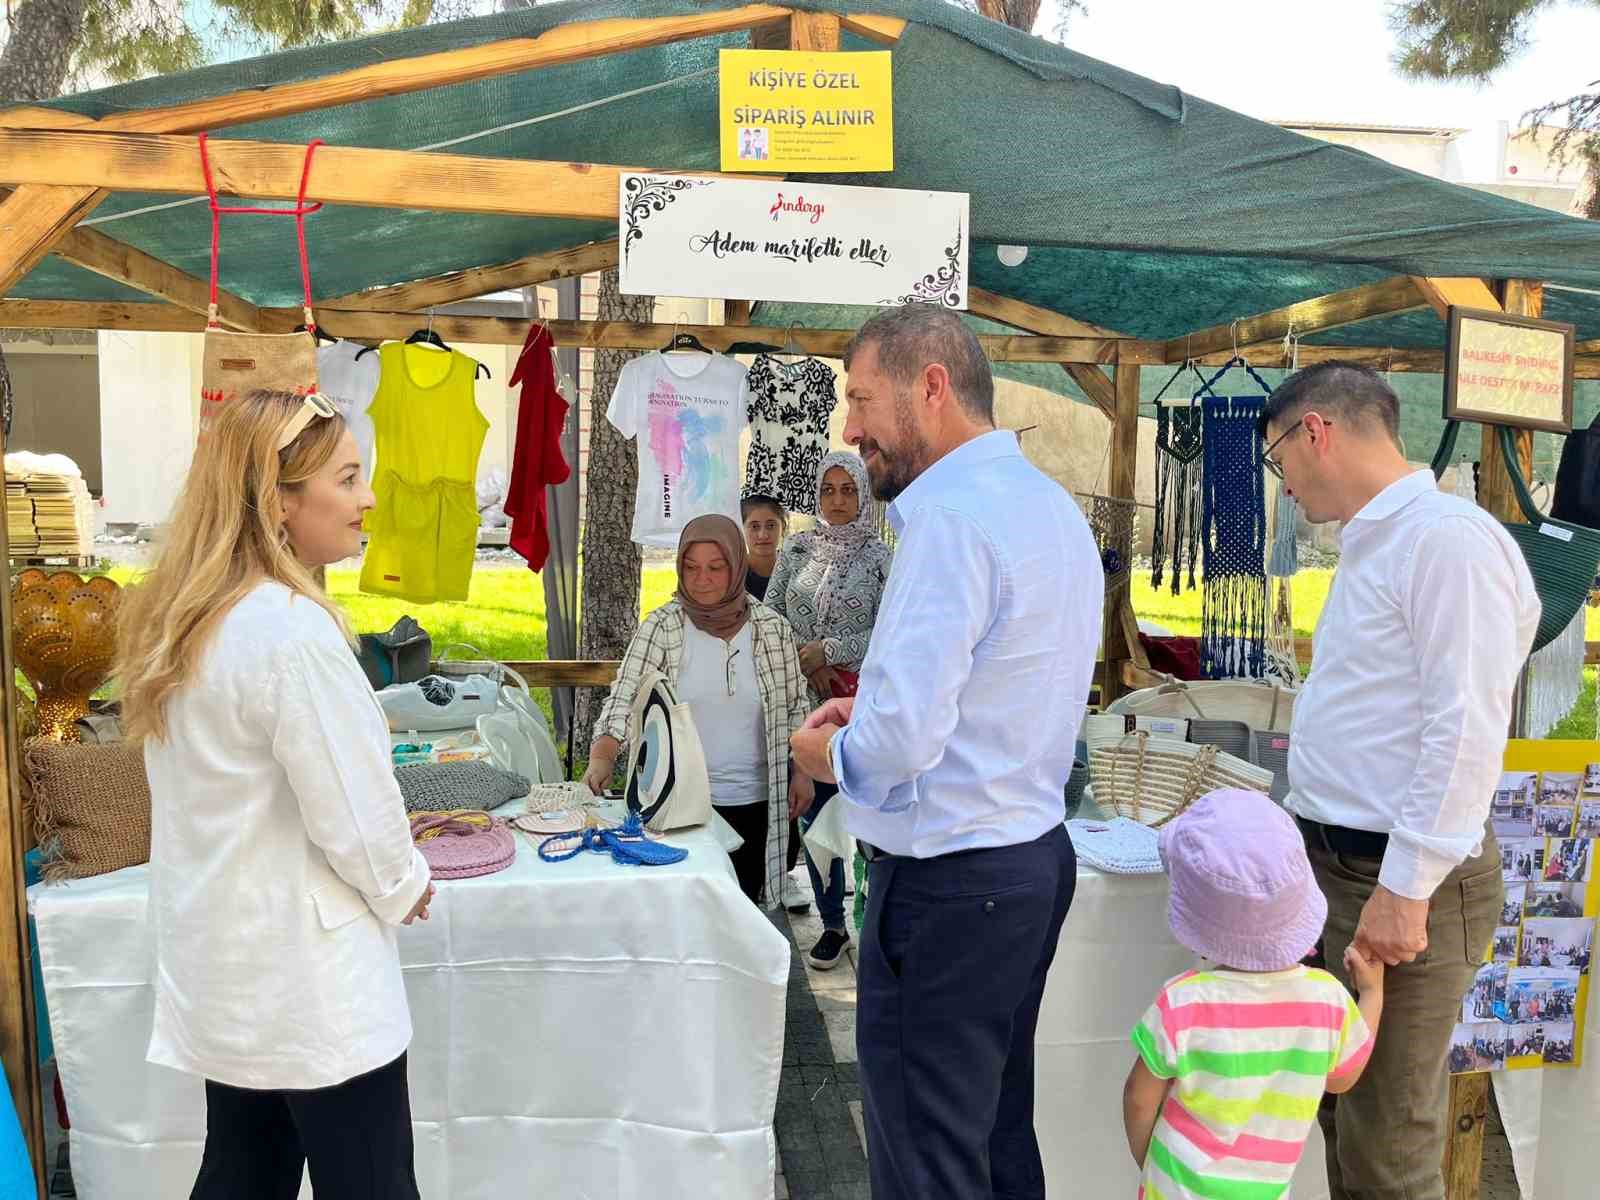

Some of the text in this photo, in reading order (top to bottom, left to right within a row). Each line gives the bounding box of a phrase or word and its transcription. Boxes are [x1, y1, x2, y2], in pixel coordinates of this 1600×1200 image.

[749, 67, 860, 91] KİŞİYE ÖZEL
[733, 104, 875, 128] SİPARİŞ ALINIR
[689, 230, 891, 267] Adem marifetli eller
[663, 473, 671, 519] IMAGINE
